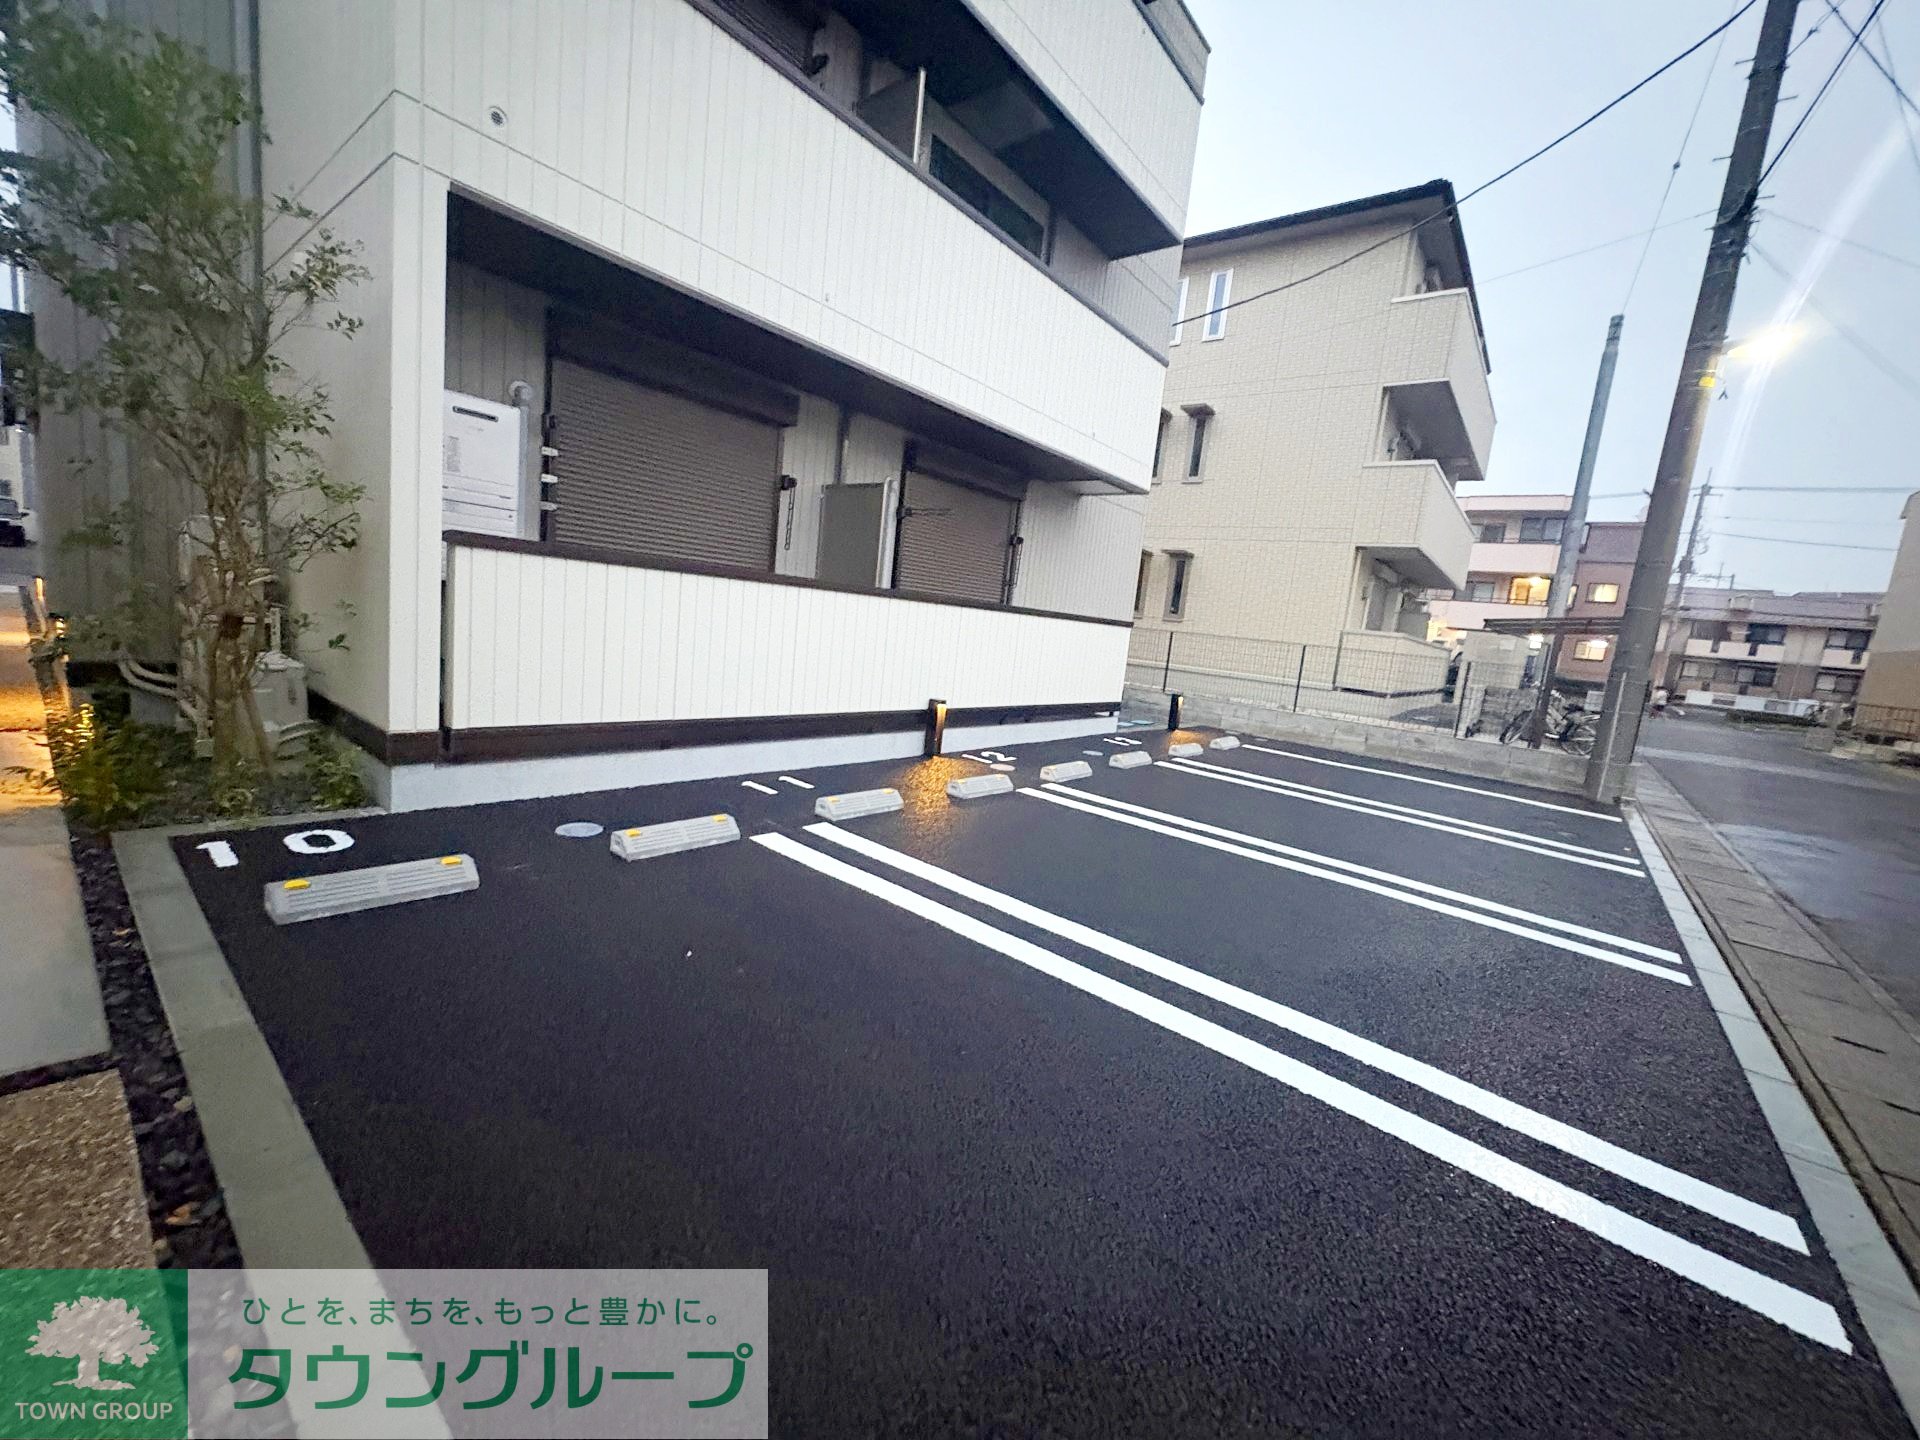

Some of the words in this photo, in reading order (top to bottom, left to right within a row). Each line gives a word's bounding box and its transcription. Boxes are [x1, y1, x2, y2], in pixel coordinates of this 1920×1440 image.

[961, 751, 1018, 764] 12
[741, 775, 816, 795] 11
[196, 829, 355, 868] 10
